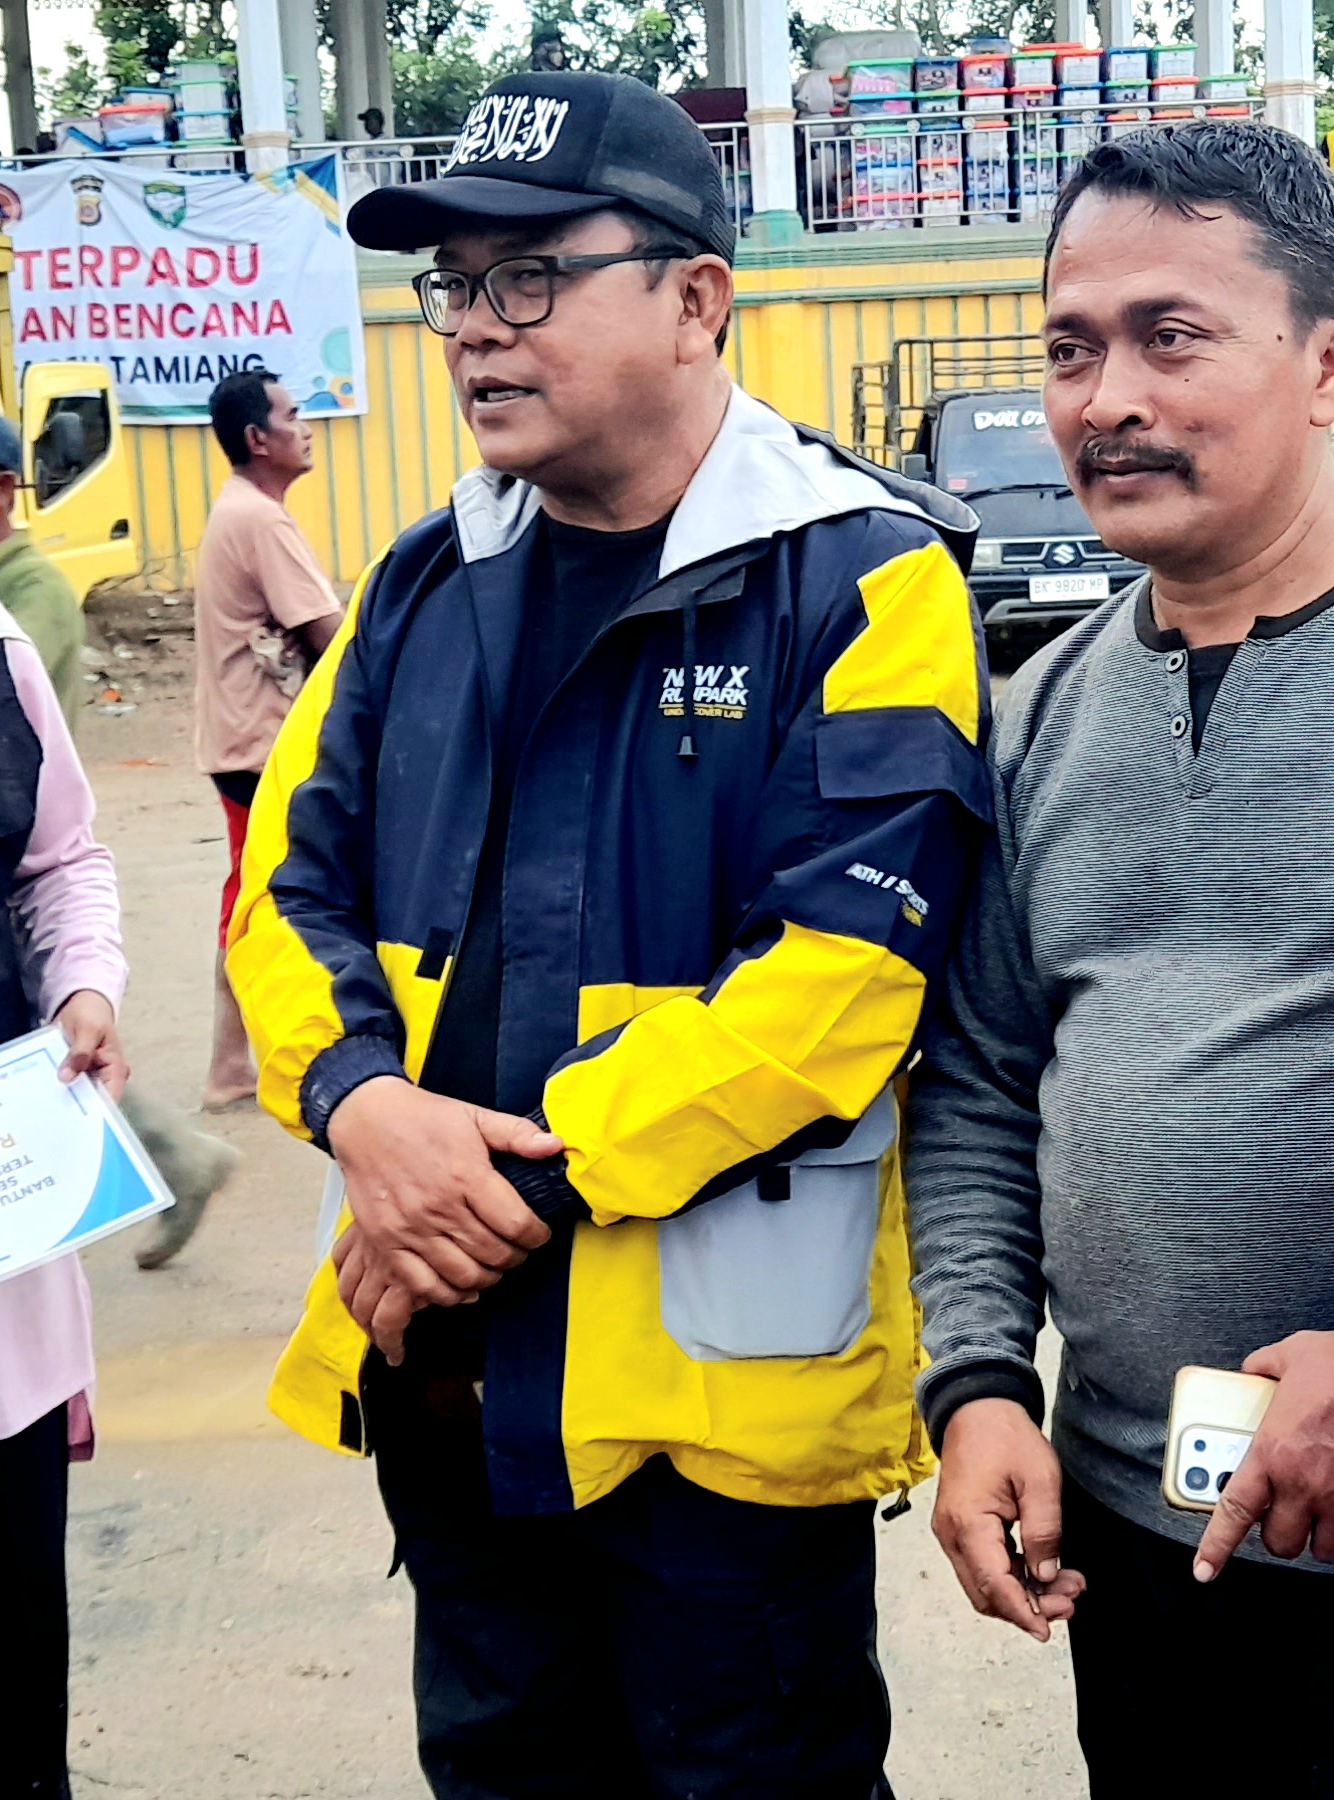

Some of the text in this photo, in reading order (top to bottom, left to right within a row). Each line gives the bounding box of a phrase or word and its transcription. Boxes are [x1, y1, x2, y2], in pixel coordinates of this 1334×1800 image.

[17, 244, 259, 291] TERPADU
[19, 299, 293, 343] AN BENCANA
[111, 352, 266, 385] TAMIANG
[1034, 580, 1051, 594] BK
[1055, 578, 1084, 592] 9820
[662, 665, 750, 688] NW X
